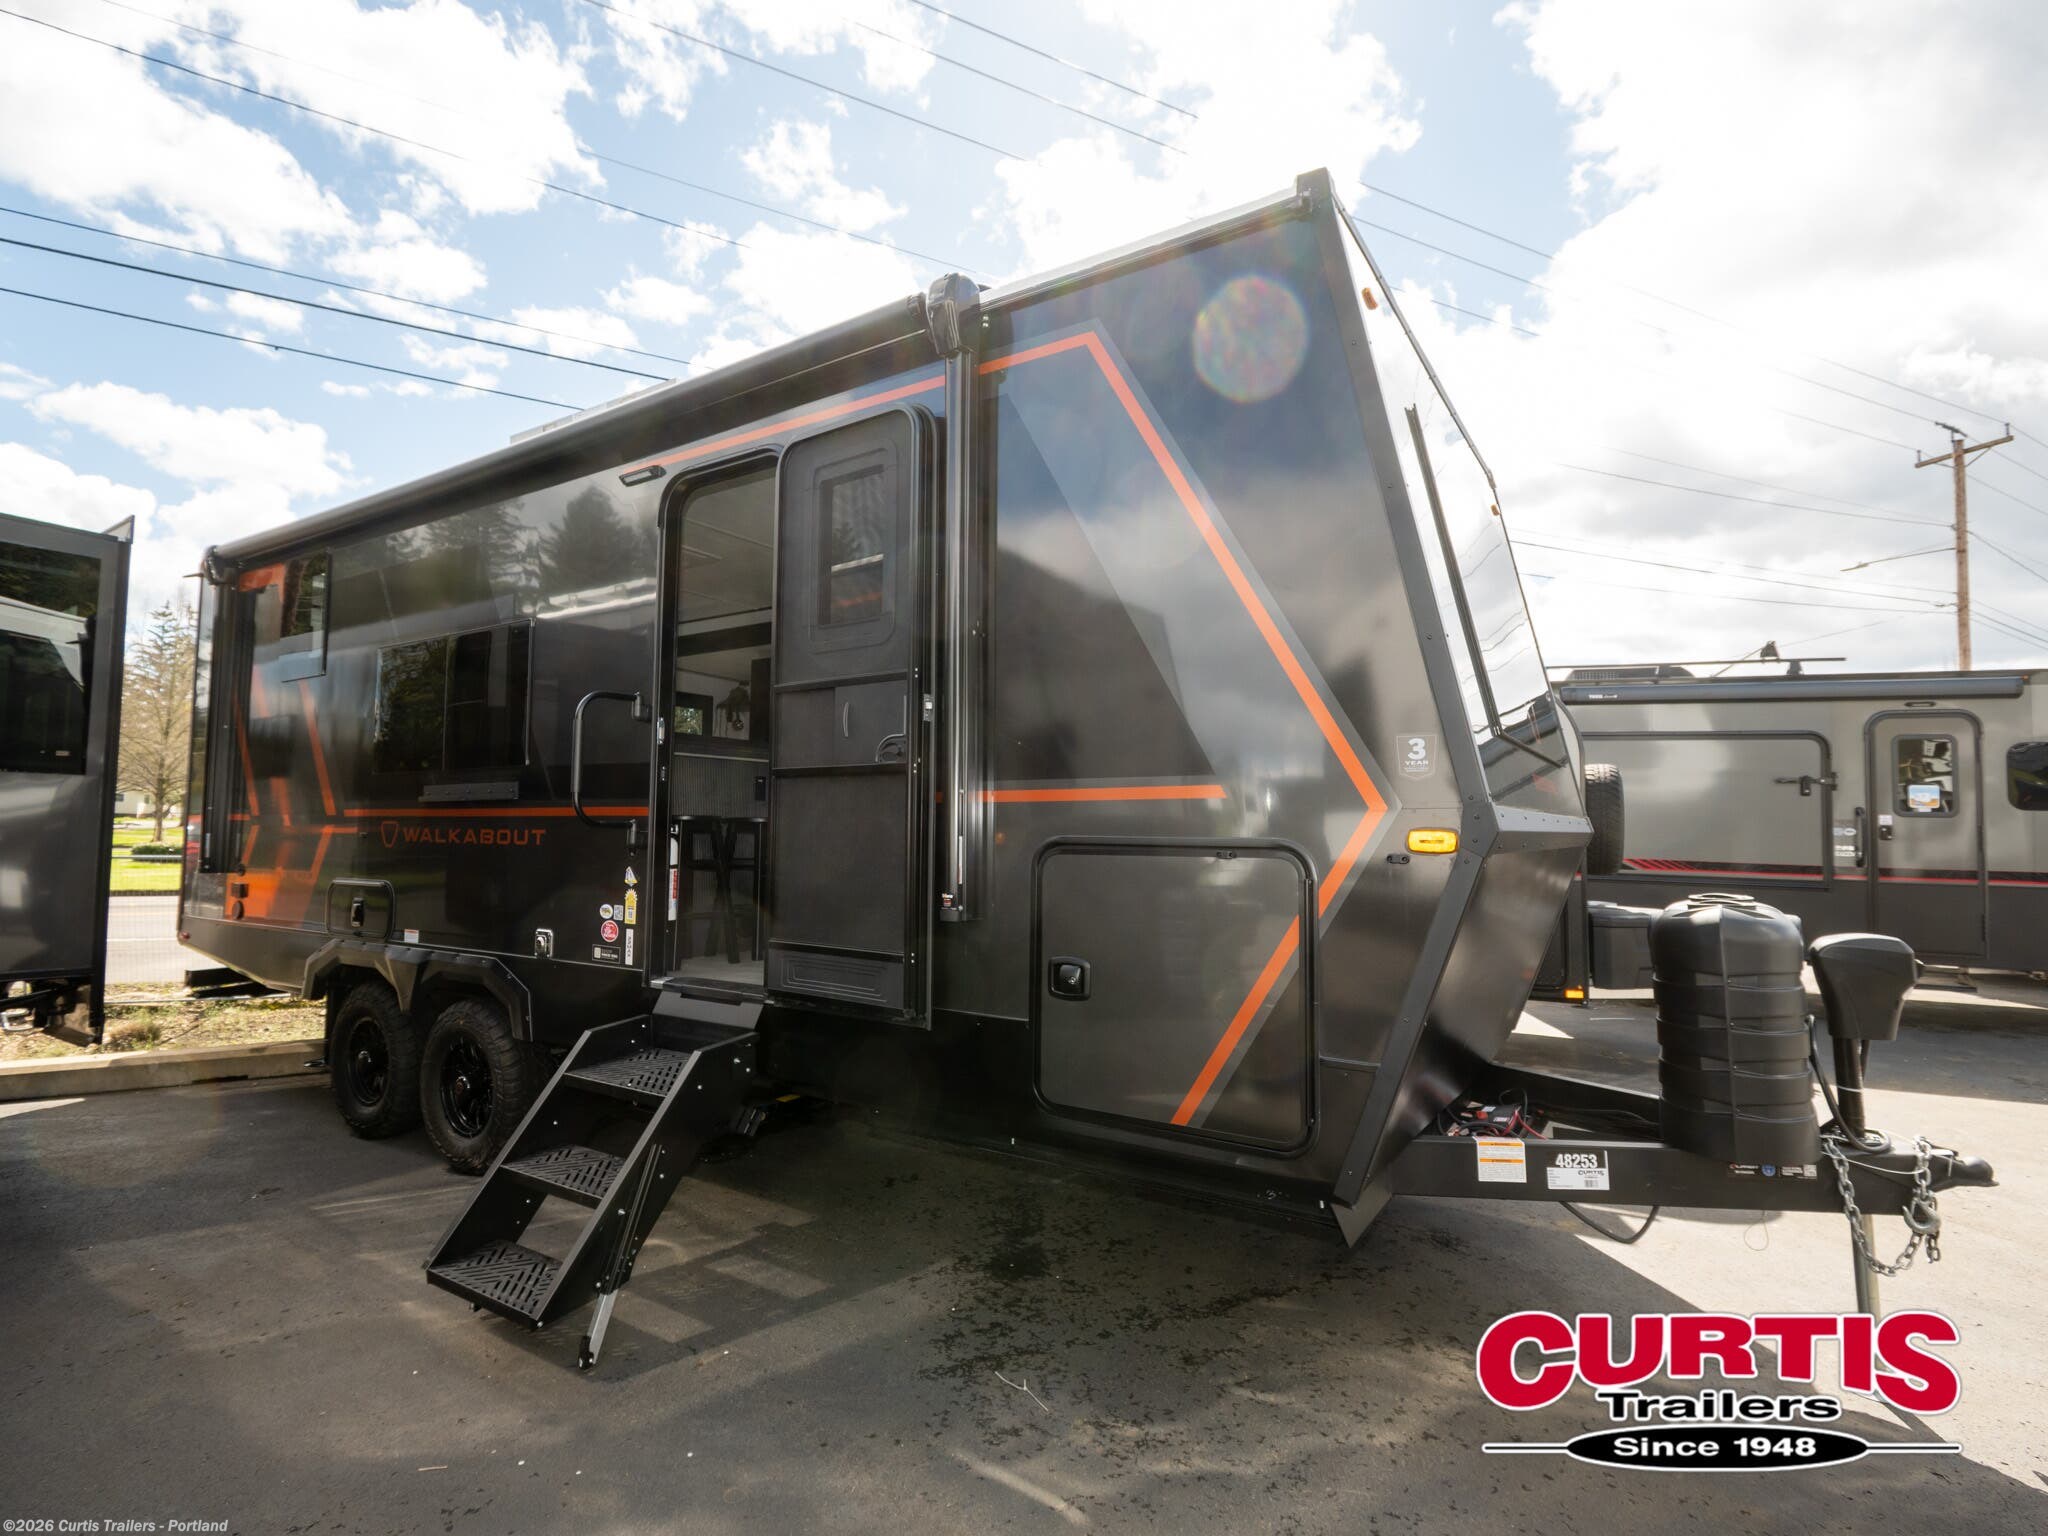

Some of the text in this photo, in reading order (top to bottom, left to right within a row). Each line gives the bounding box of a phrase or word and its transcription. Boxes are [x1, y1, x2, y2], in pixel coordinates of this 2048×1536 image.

[1407, 737, 1426, 760] 3
[403, 827, 546, 845] WALKABOUT
[1555, 1153, 1598, 1168] 48253
